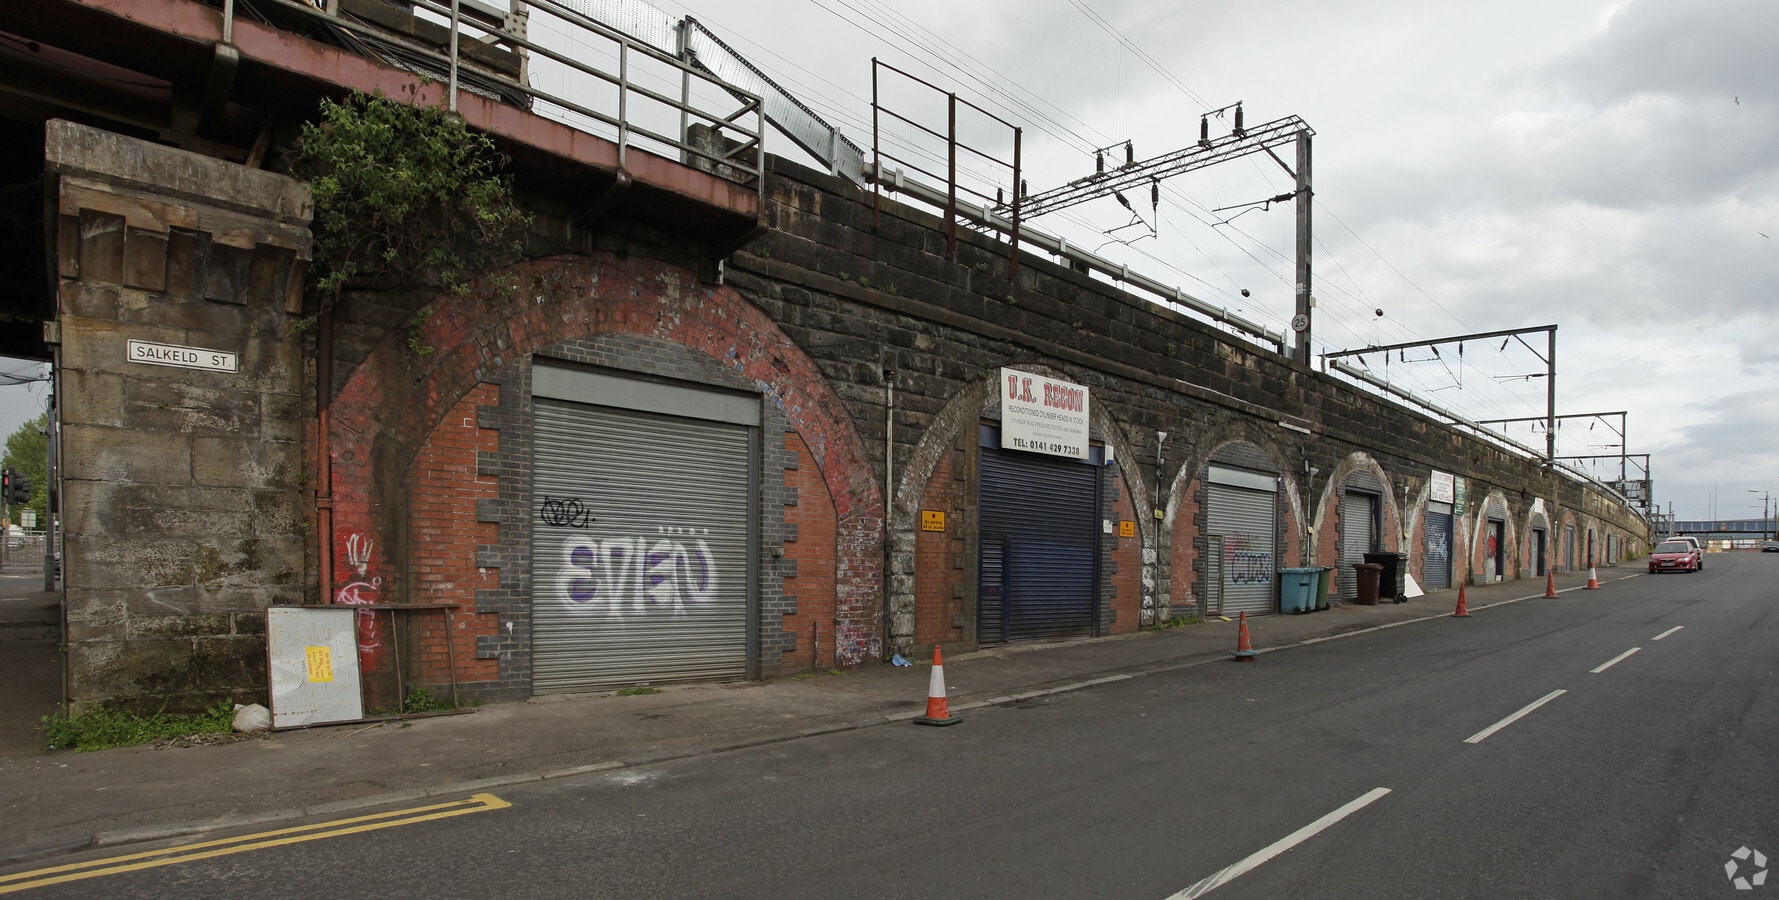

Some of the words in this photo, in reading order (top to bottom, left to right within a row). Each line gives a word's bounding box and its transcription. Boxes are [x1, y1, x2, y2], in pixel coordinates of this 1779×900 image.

[1295, 318, 1306, 327] 25
[137, 346, 198, 363] SALKELD
[212, 355, 231, 367] ST.
[1008, 375, 1036, 403] U.K.
[1044, 382, 1083, 412] RECON
[1008, 405, 1039, 417] RECONDITIONED
[1040, 411, 1057, 420] CYLINDER
[1057, 414, 1068, 423] HEADS
[1073, 417, 1084, 425] STOCK
[1010, 417, 1026, 425] CYLINDER
[1035, 421, 1051, 430] PRESSURE
[1013, 438, 1028, 448] TEL:
[1030, 440, 1047, 450] 0141
[1049, 443, 1061, 452] 429
[1063, 445, 1080, 456] 7338
